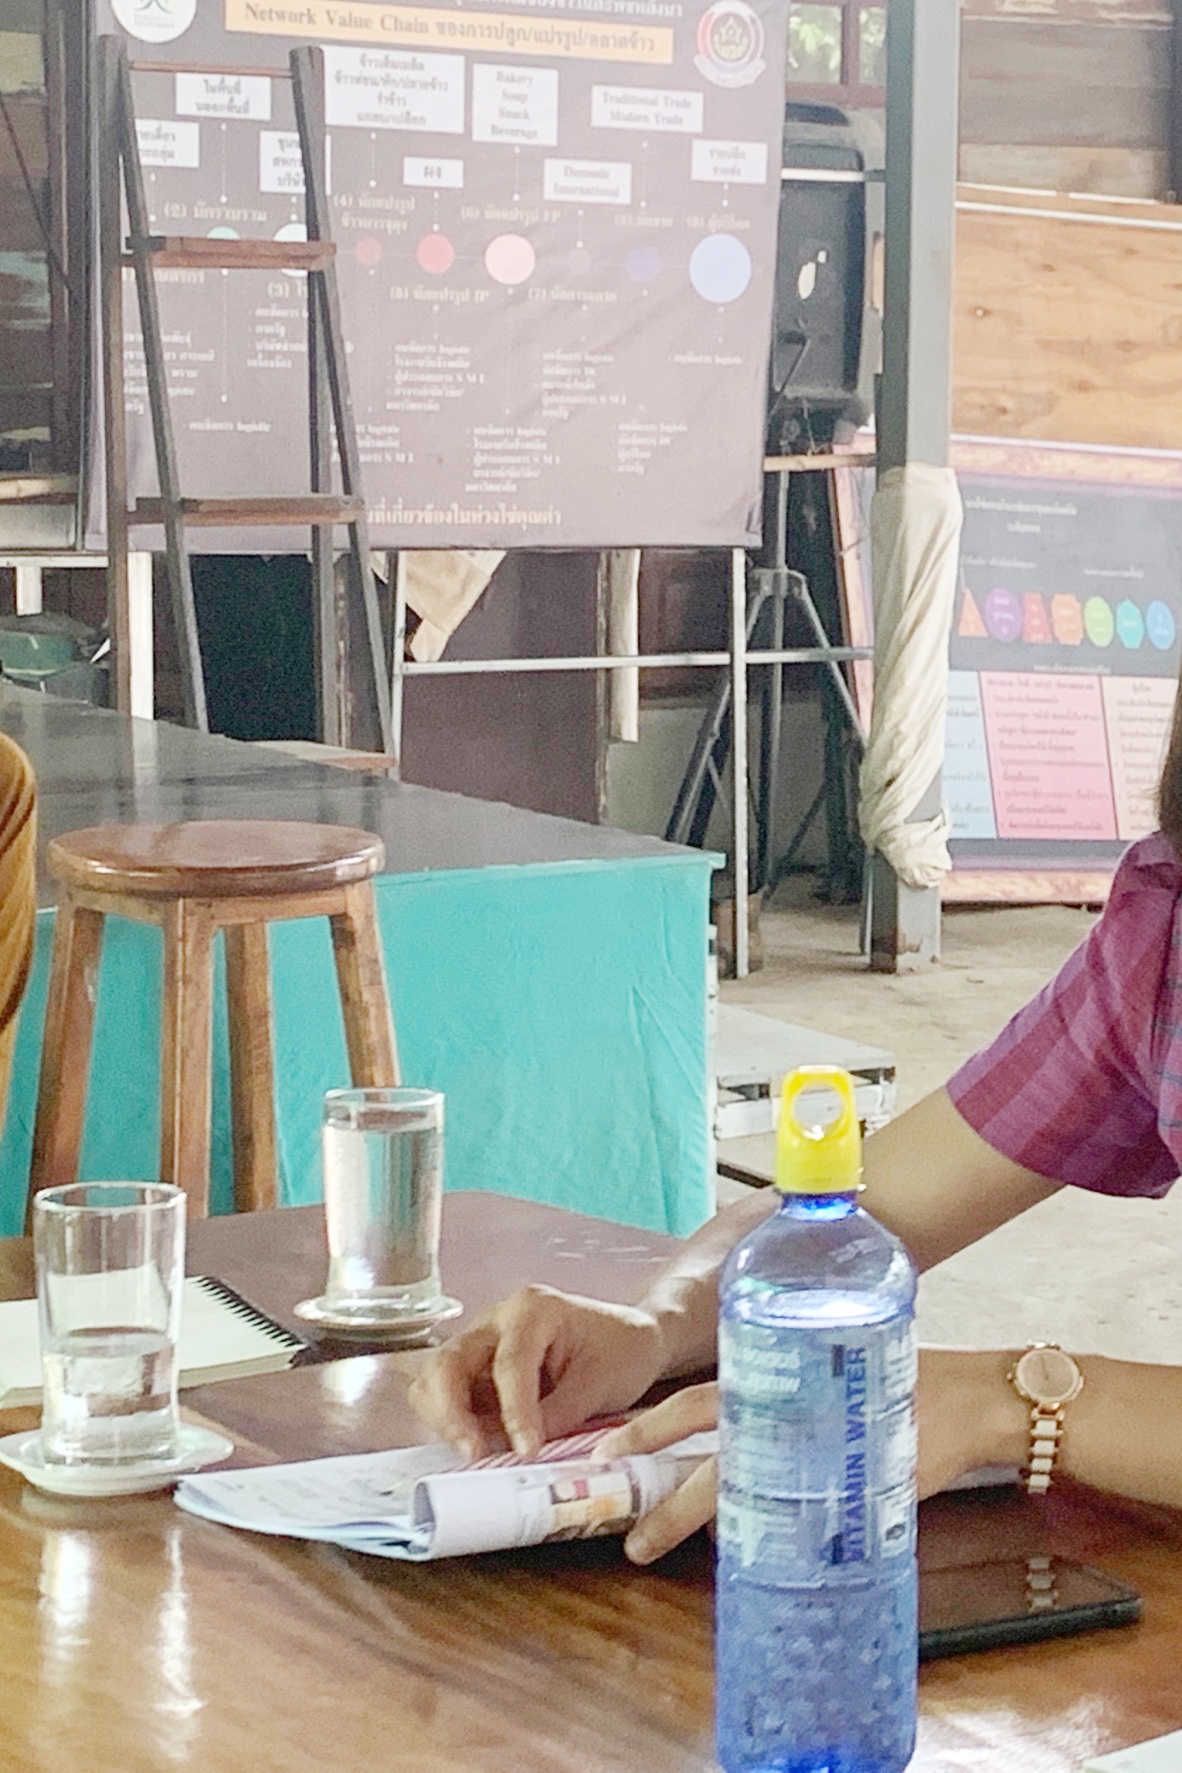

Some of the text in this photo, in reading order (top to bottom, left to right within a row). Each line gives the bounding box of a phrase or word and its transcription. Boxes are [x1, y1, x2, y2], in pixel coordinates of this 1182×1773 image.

[244, 3, 316, 26] Network
[325, 9, 373, 29] Value
[380, 13, 428, 34] Chain
[496, 71, 534, 87] Bakery
[502, 89, 528, 104] Soup
[602, 92, 692, 110] Traditional Trade
[498, 106, 530, 121] Snack
[610, 110, 684, 126] Modern Trade
[490, 124, 538, 139] Beverage
[563, 165, 610, 180] Domestic
[553, 182, 619, 198] International
[844, 1345, 868, 1563] VITAMIN WATER
